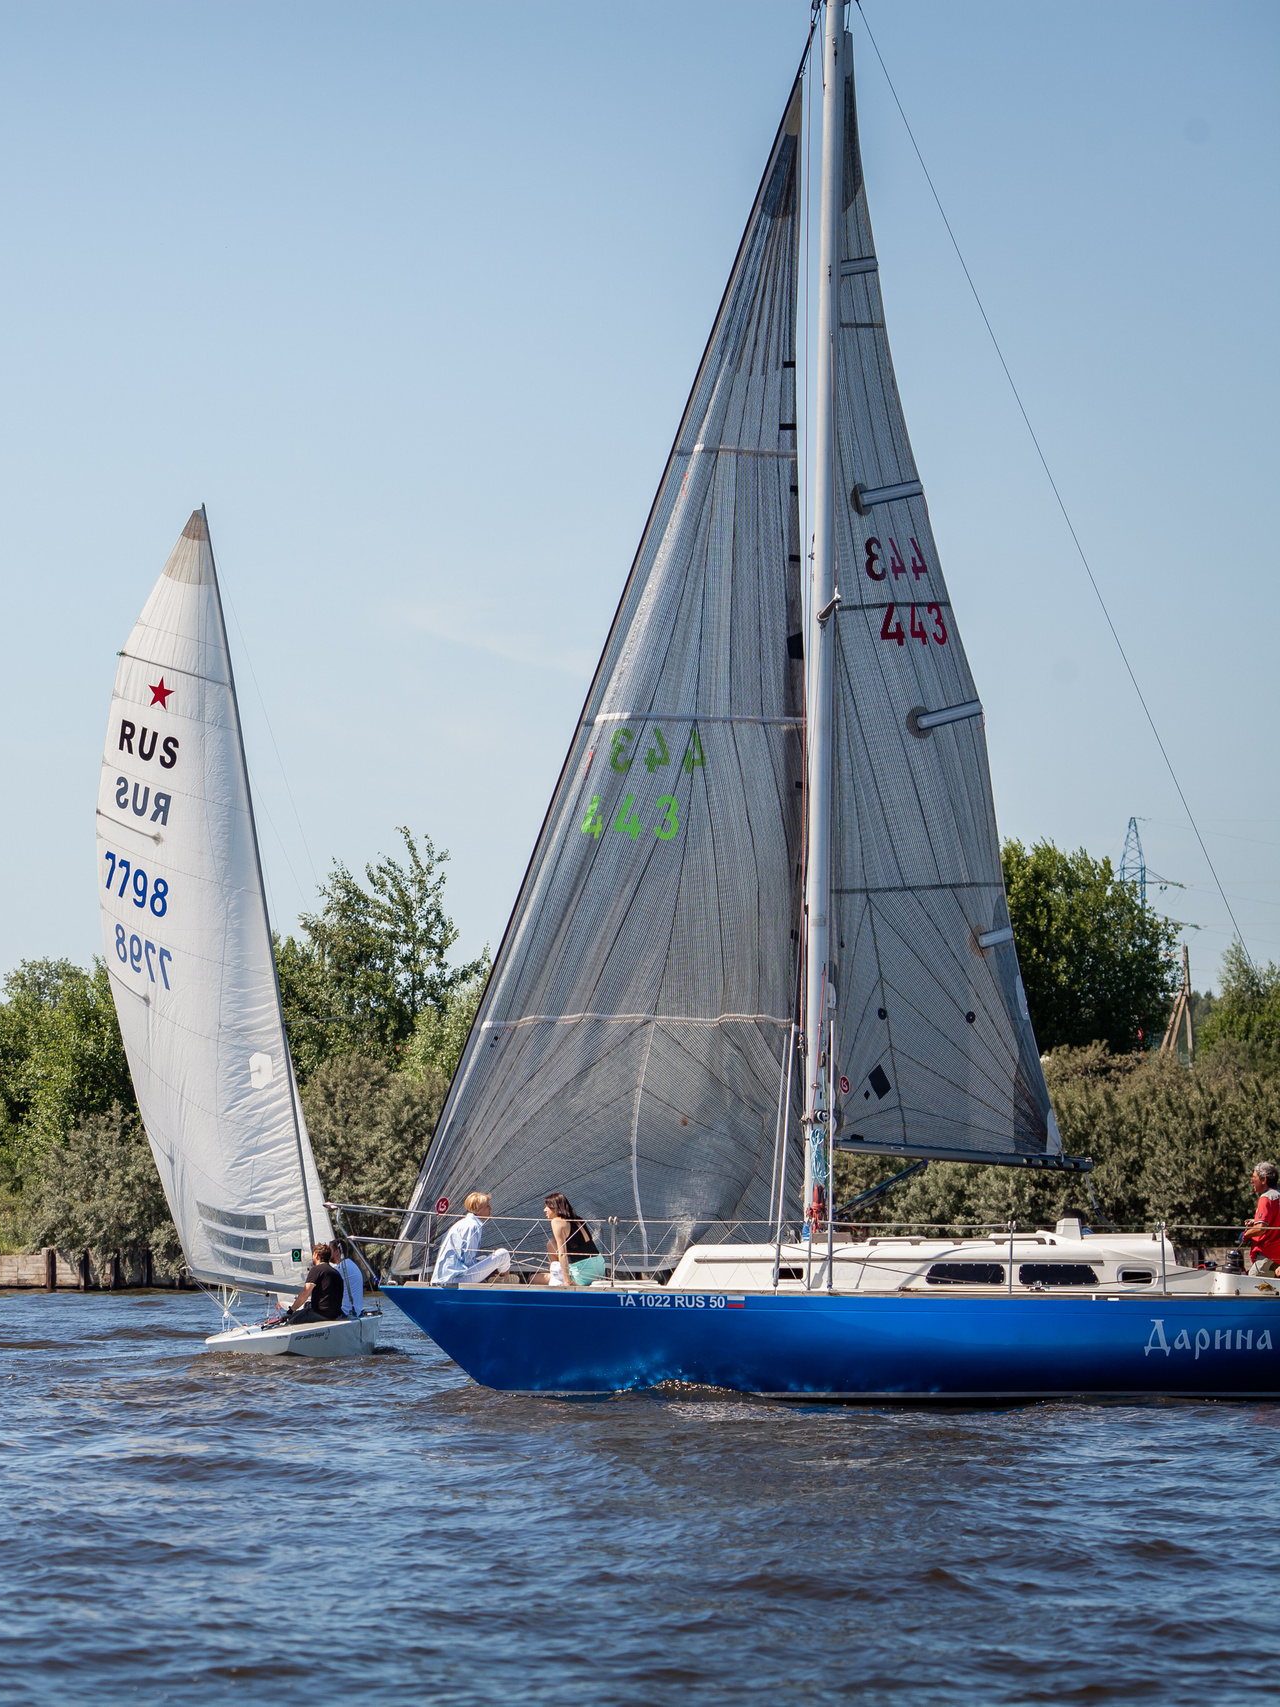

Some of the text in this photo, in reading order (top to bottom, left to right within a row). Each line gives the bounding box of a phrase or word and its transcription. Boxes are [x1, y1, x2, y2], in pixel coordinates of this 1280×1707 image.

[880, 602, 947, 646] 443
[118, 719, 180, 769] RUS
[581, 794, 679, 840] 443
[105, 850, 169, 917] 7798
[617, 1294, 725, 1309] TA 1022 RUS 50
[1144, 1319, 1273, 1360] Дарина
